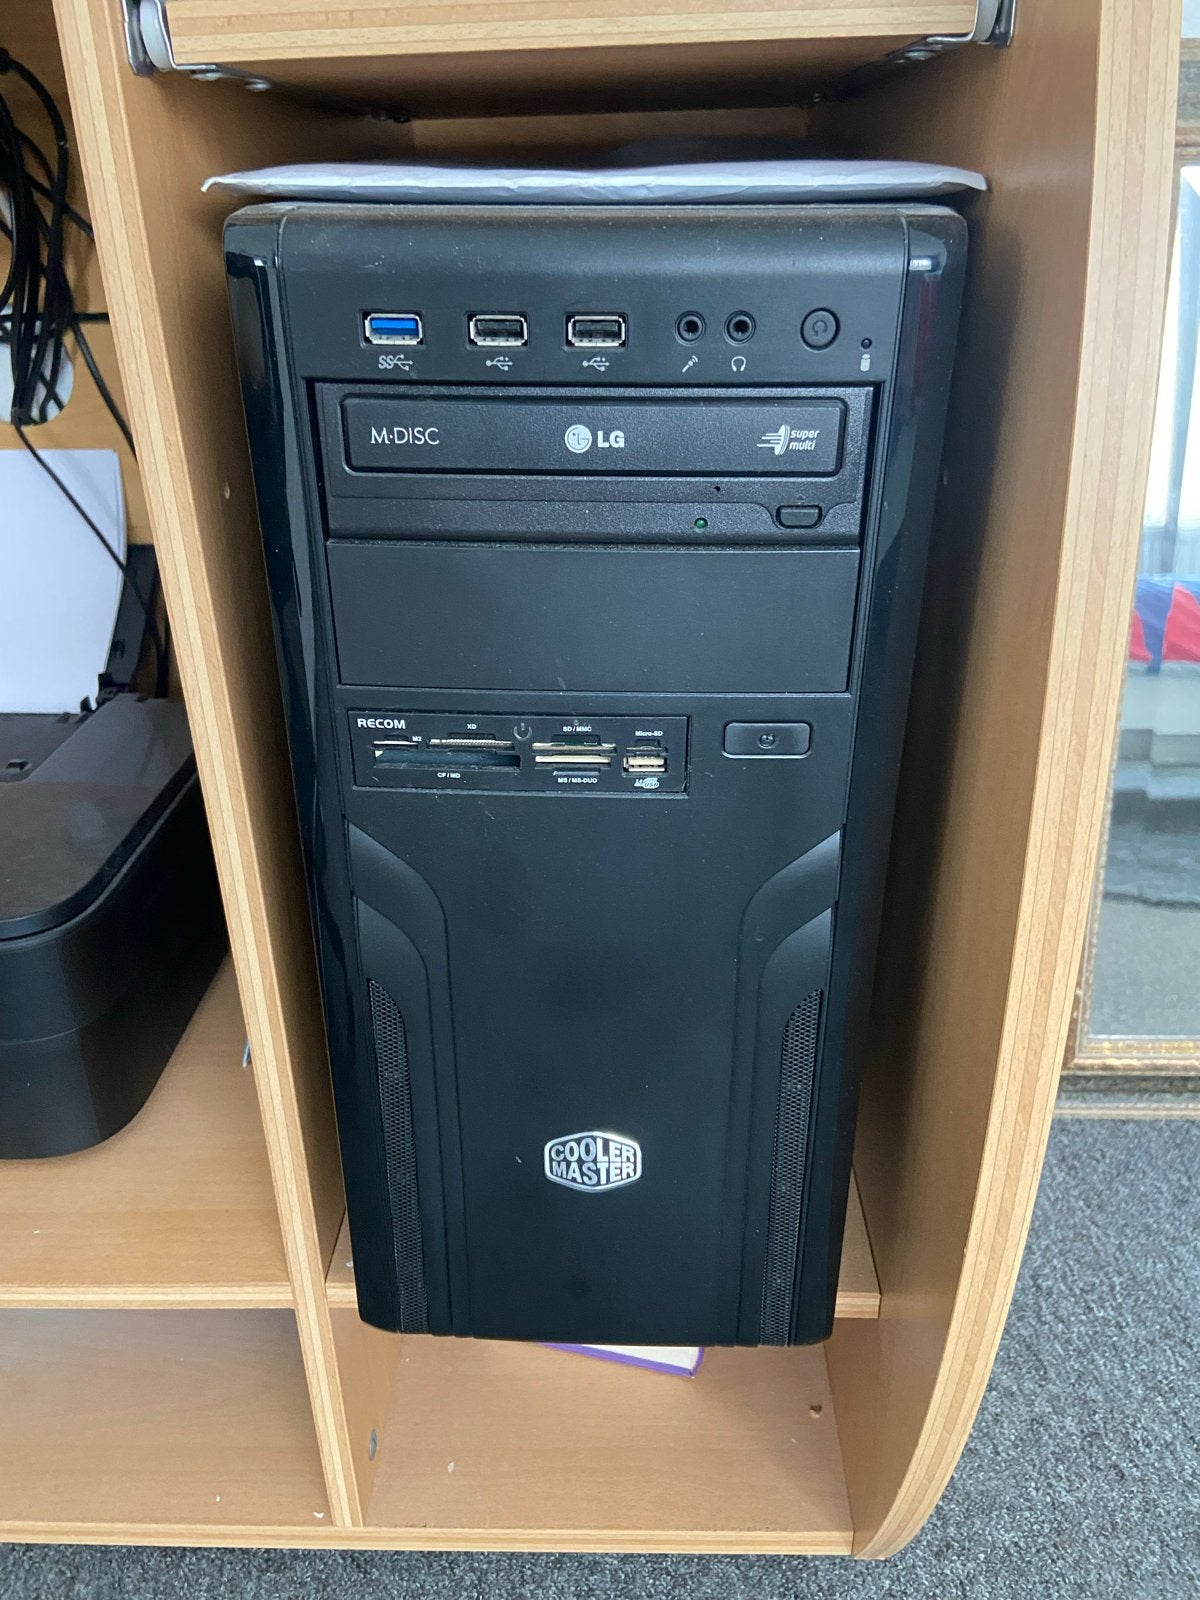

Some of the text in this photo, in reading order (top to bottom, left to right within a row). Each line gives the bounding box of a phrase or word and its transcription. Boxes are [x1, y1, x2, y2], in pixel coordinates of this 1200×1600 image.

[597, 430, 625, 448] LG
[790, 429, 820, 440] super
[789, 439, 816, 451] multi
[357, 718, 406, 730] RECOM
[550, 1137, 635, 1163] COOLER
[552, 1161, 635, 1185] MASTER
